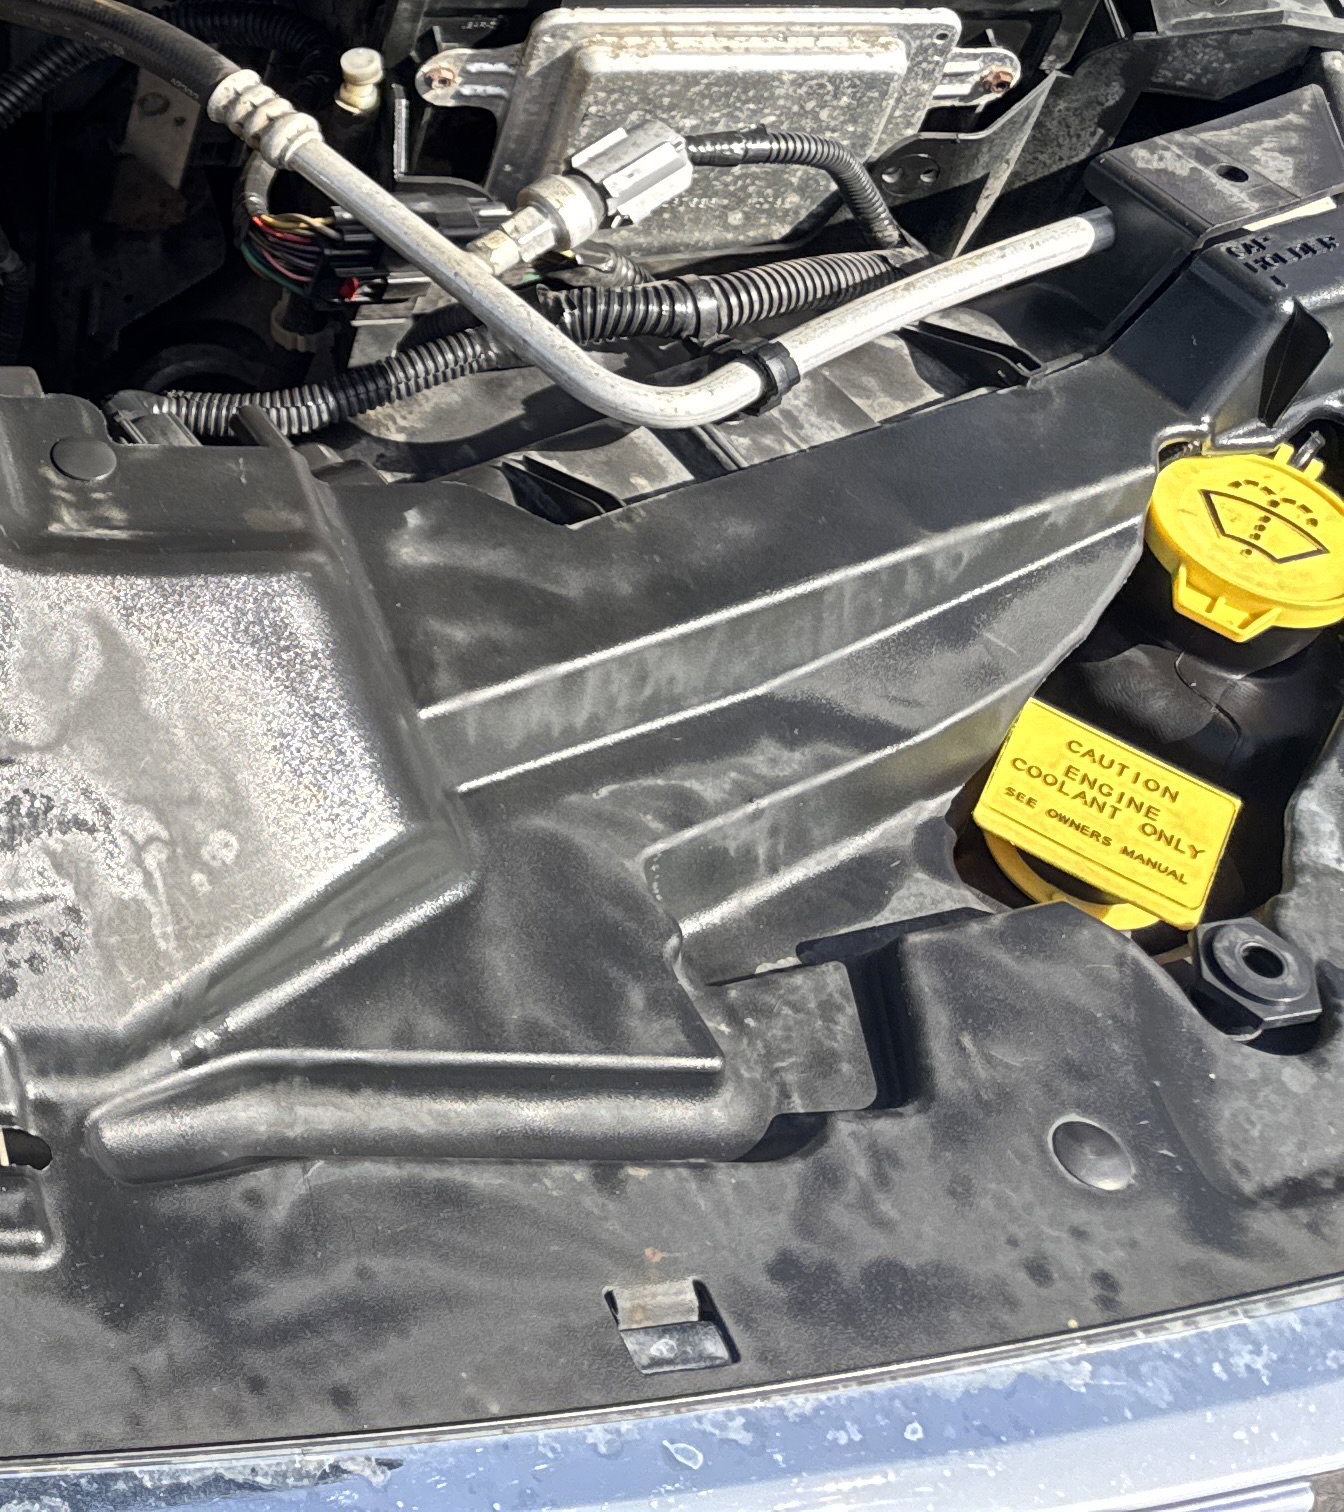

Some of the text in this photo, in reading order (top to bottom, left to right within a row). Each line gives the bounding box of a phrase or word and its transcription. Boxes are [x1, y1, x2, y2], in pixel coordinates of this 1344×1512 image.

[1010, 756, 1206, 860] COOLANT ONLY
[1063, 763, 1162, 822] ENGINE
[1066, 739, 1180, 803] CAUTION
[1004, 785, 1189, 886] SEE OWNERS MANUAL
